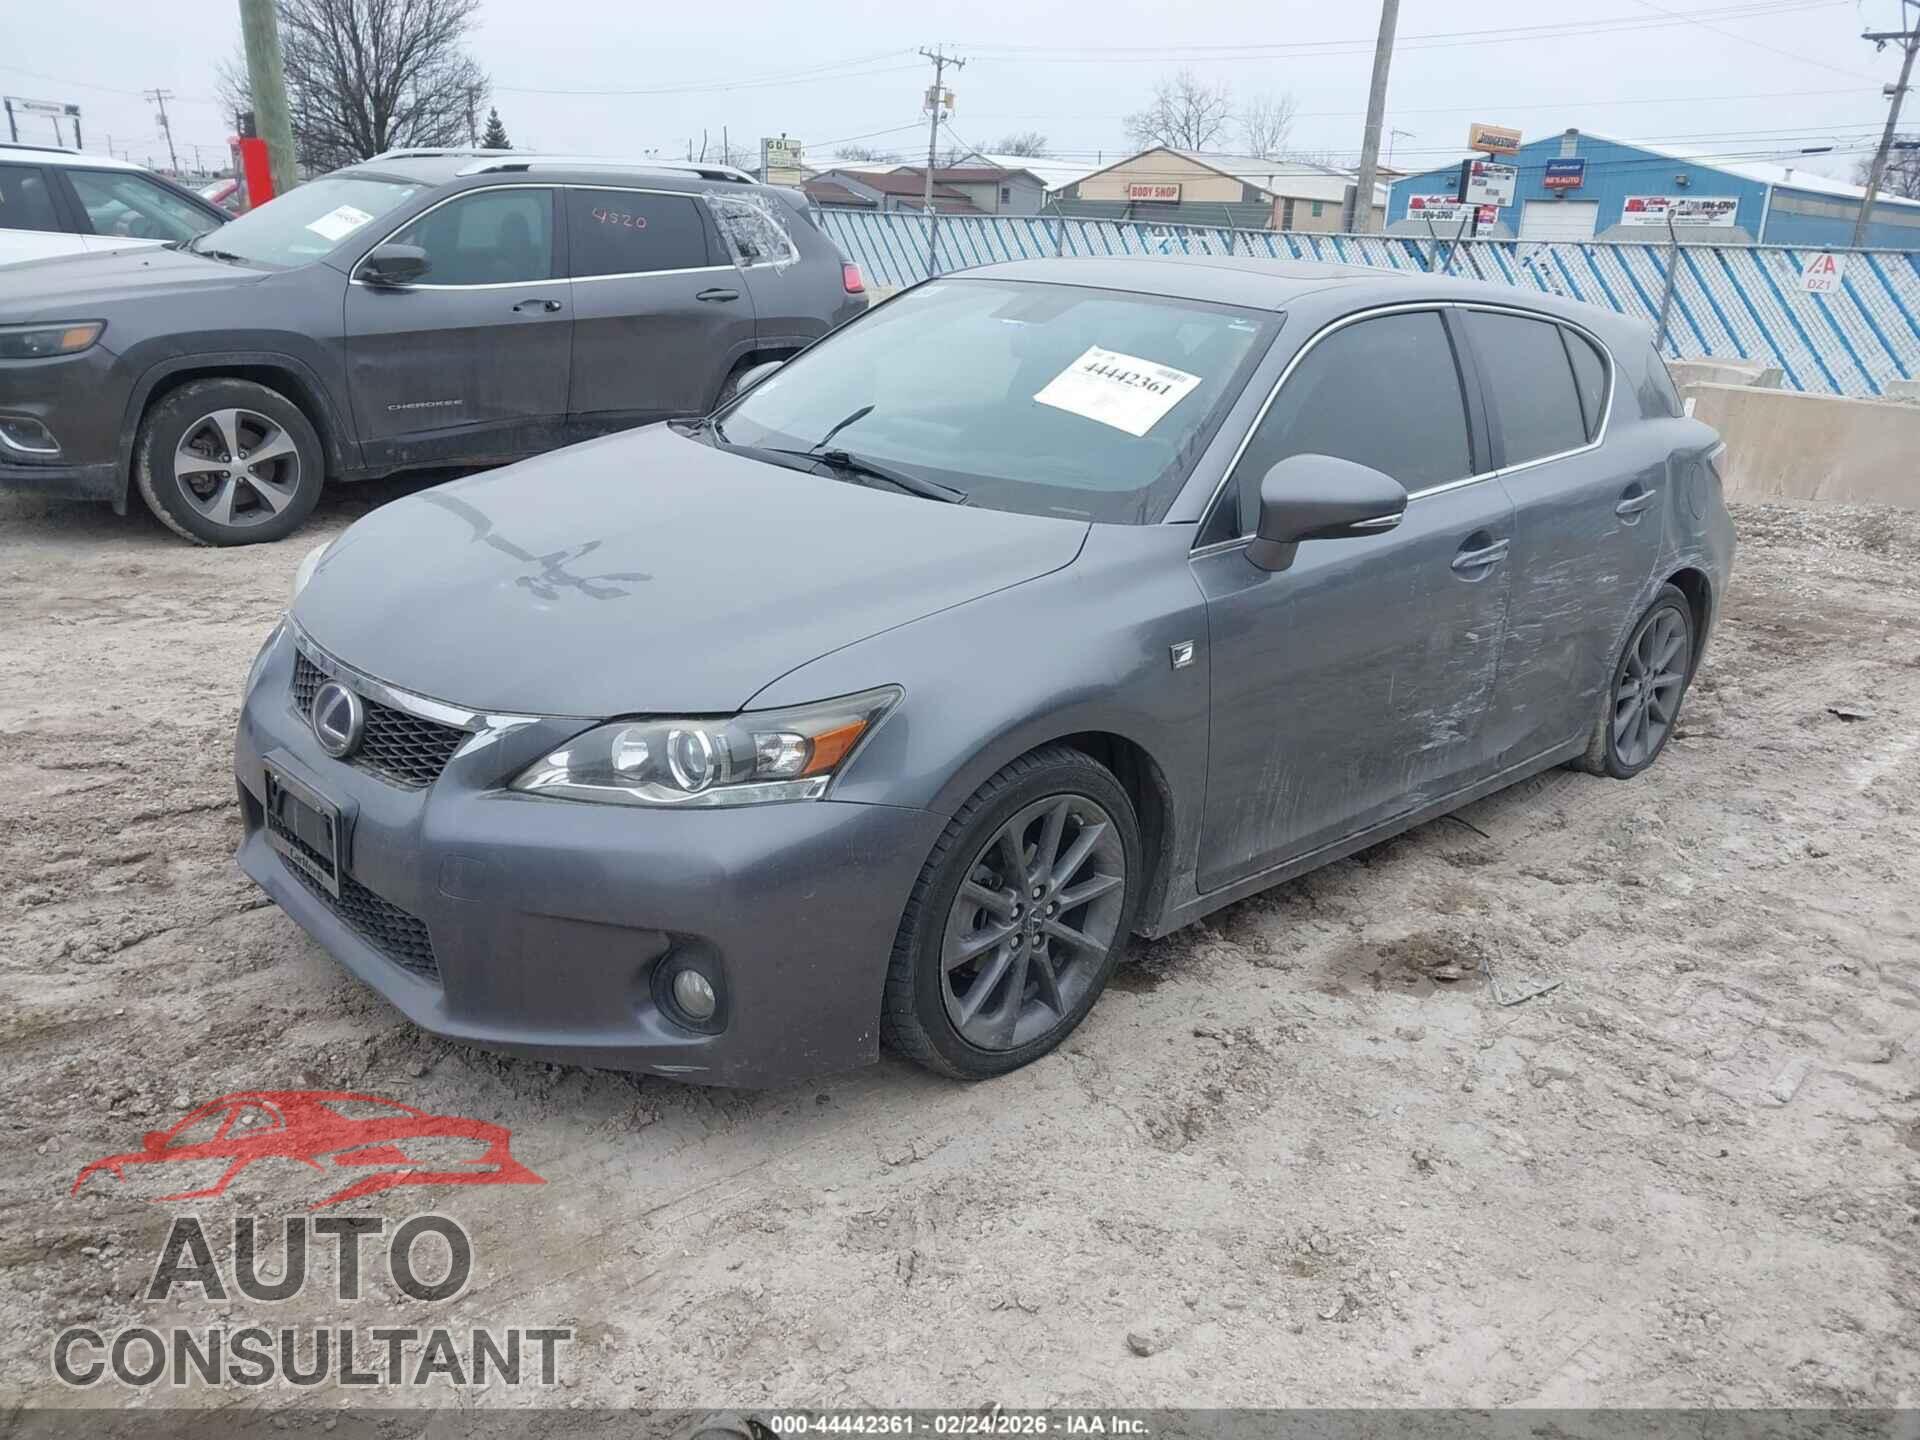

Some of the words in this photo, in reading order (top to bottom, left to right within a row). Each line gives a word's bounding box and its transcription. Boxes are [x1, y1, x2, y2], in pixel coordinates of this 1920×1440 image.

[1131, 186, 1153, 198] BODY
[1154, 186, 1177, 198] SHOP
[592, 207, 648, 229] 4520
[1083, 361, 1173, 396] 44442361
[386, 399, 464, 412] CHEROKEE
